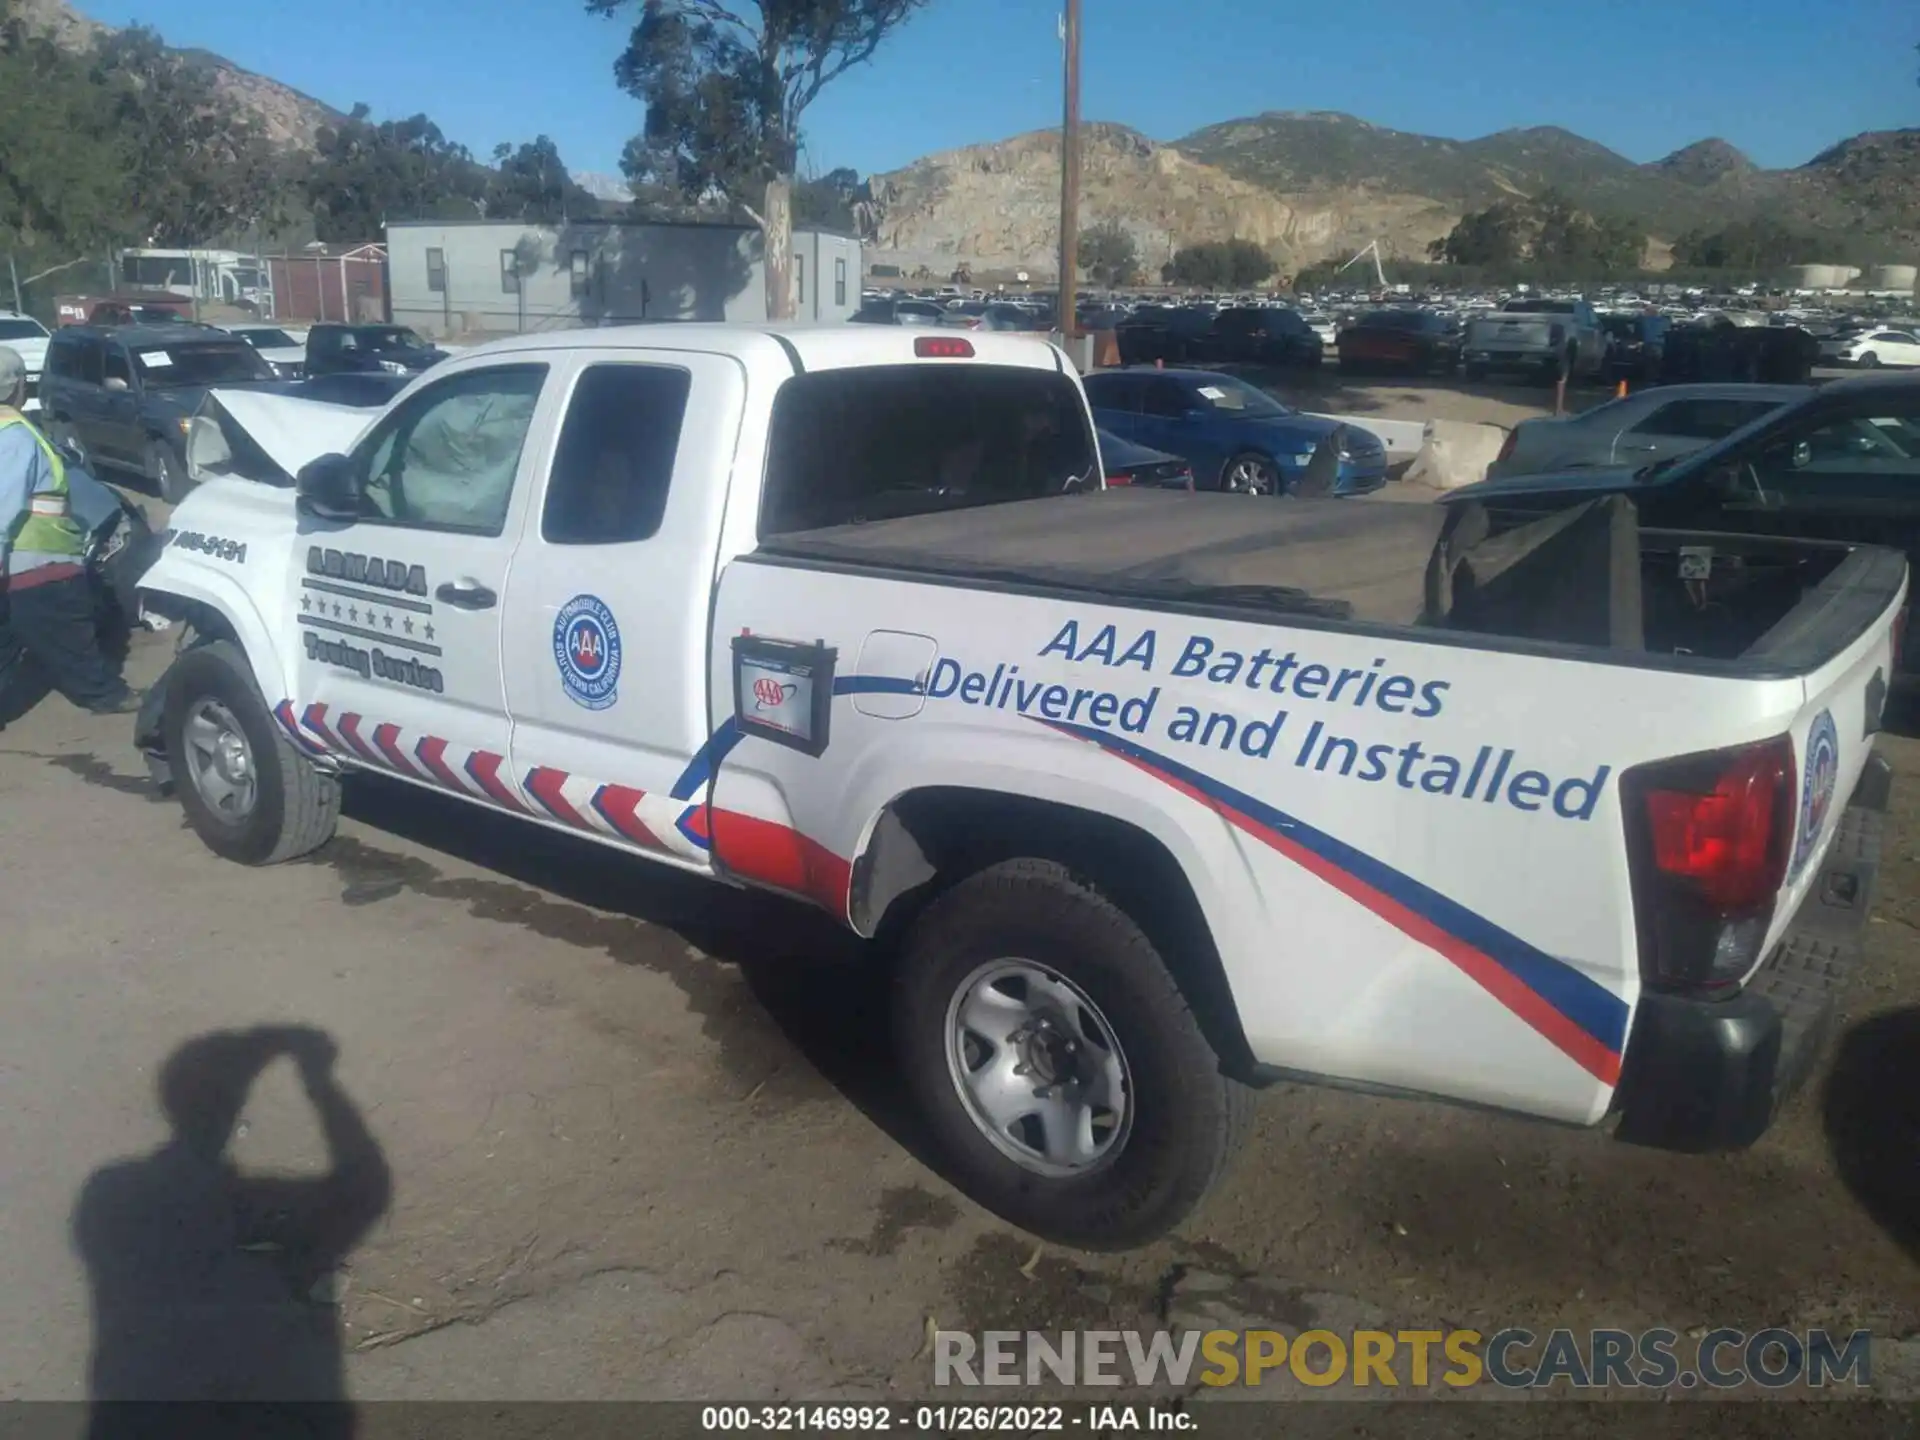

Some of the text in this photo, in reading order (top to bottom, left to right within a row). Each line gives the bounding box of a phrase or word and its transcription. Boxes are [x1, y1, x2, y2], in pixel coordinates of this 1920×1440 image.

[306, 545, 427, 597] ARMADA
[570, 629, 603, 657] AAA
[600, 609, 618, 640] CLUB
[303, 631, 444, 694] Towing Service
[1038, 619, 1451, 719] AAA Batteries
[928, 656, 1611, 822] Delivered and Installed
